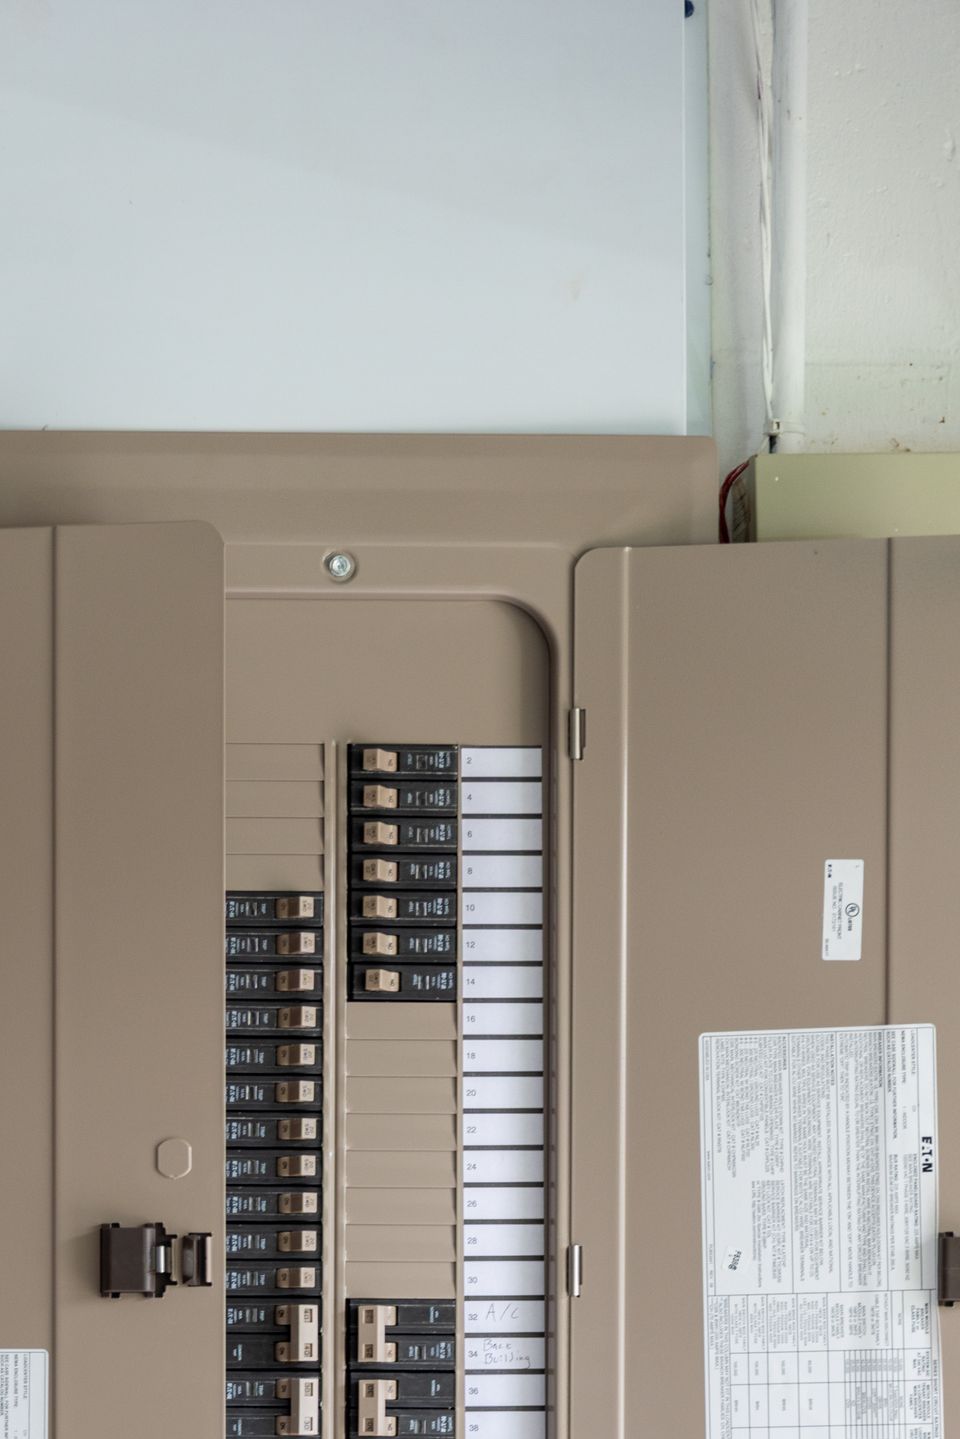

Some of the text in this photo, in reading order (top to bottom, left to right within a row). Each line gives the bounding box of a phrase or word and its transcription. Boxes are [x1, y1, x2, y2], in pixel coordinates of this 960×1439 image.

[466, 904, 475, 912] 10
[466, 941, 476, 949] 12
[466, 978, 476, 986] 14
[466, 1015, 476, 1023] 16
[466, 1052, 476, 1060] 18
[466, 1089, 477, 1097] 20
[466, 1126, 477, 1134] 22
[466, 1163, 477, 1171] 24
[467, 1200, 477, 1208] 26
[467, 1237, 478, 1245] 28
[468, 1276, 478, 1284] 30
[467, 1313, 478, 1321] 32
[485, 1304, 520, 1322] A/C
[468, 1350, 478, 1358] 34
[468, 1387, 479, 1395] 36
[468, 1424, 479, 1432] 38
